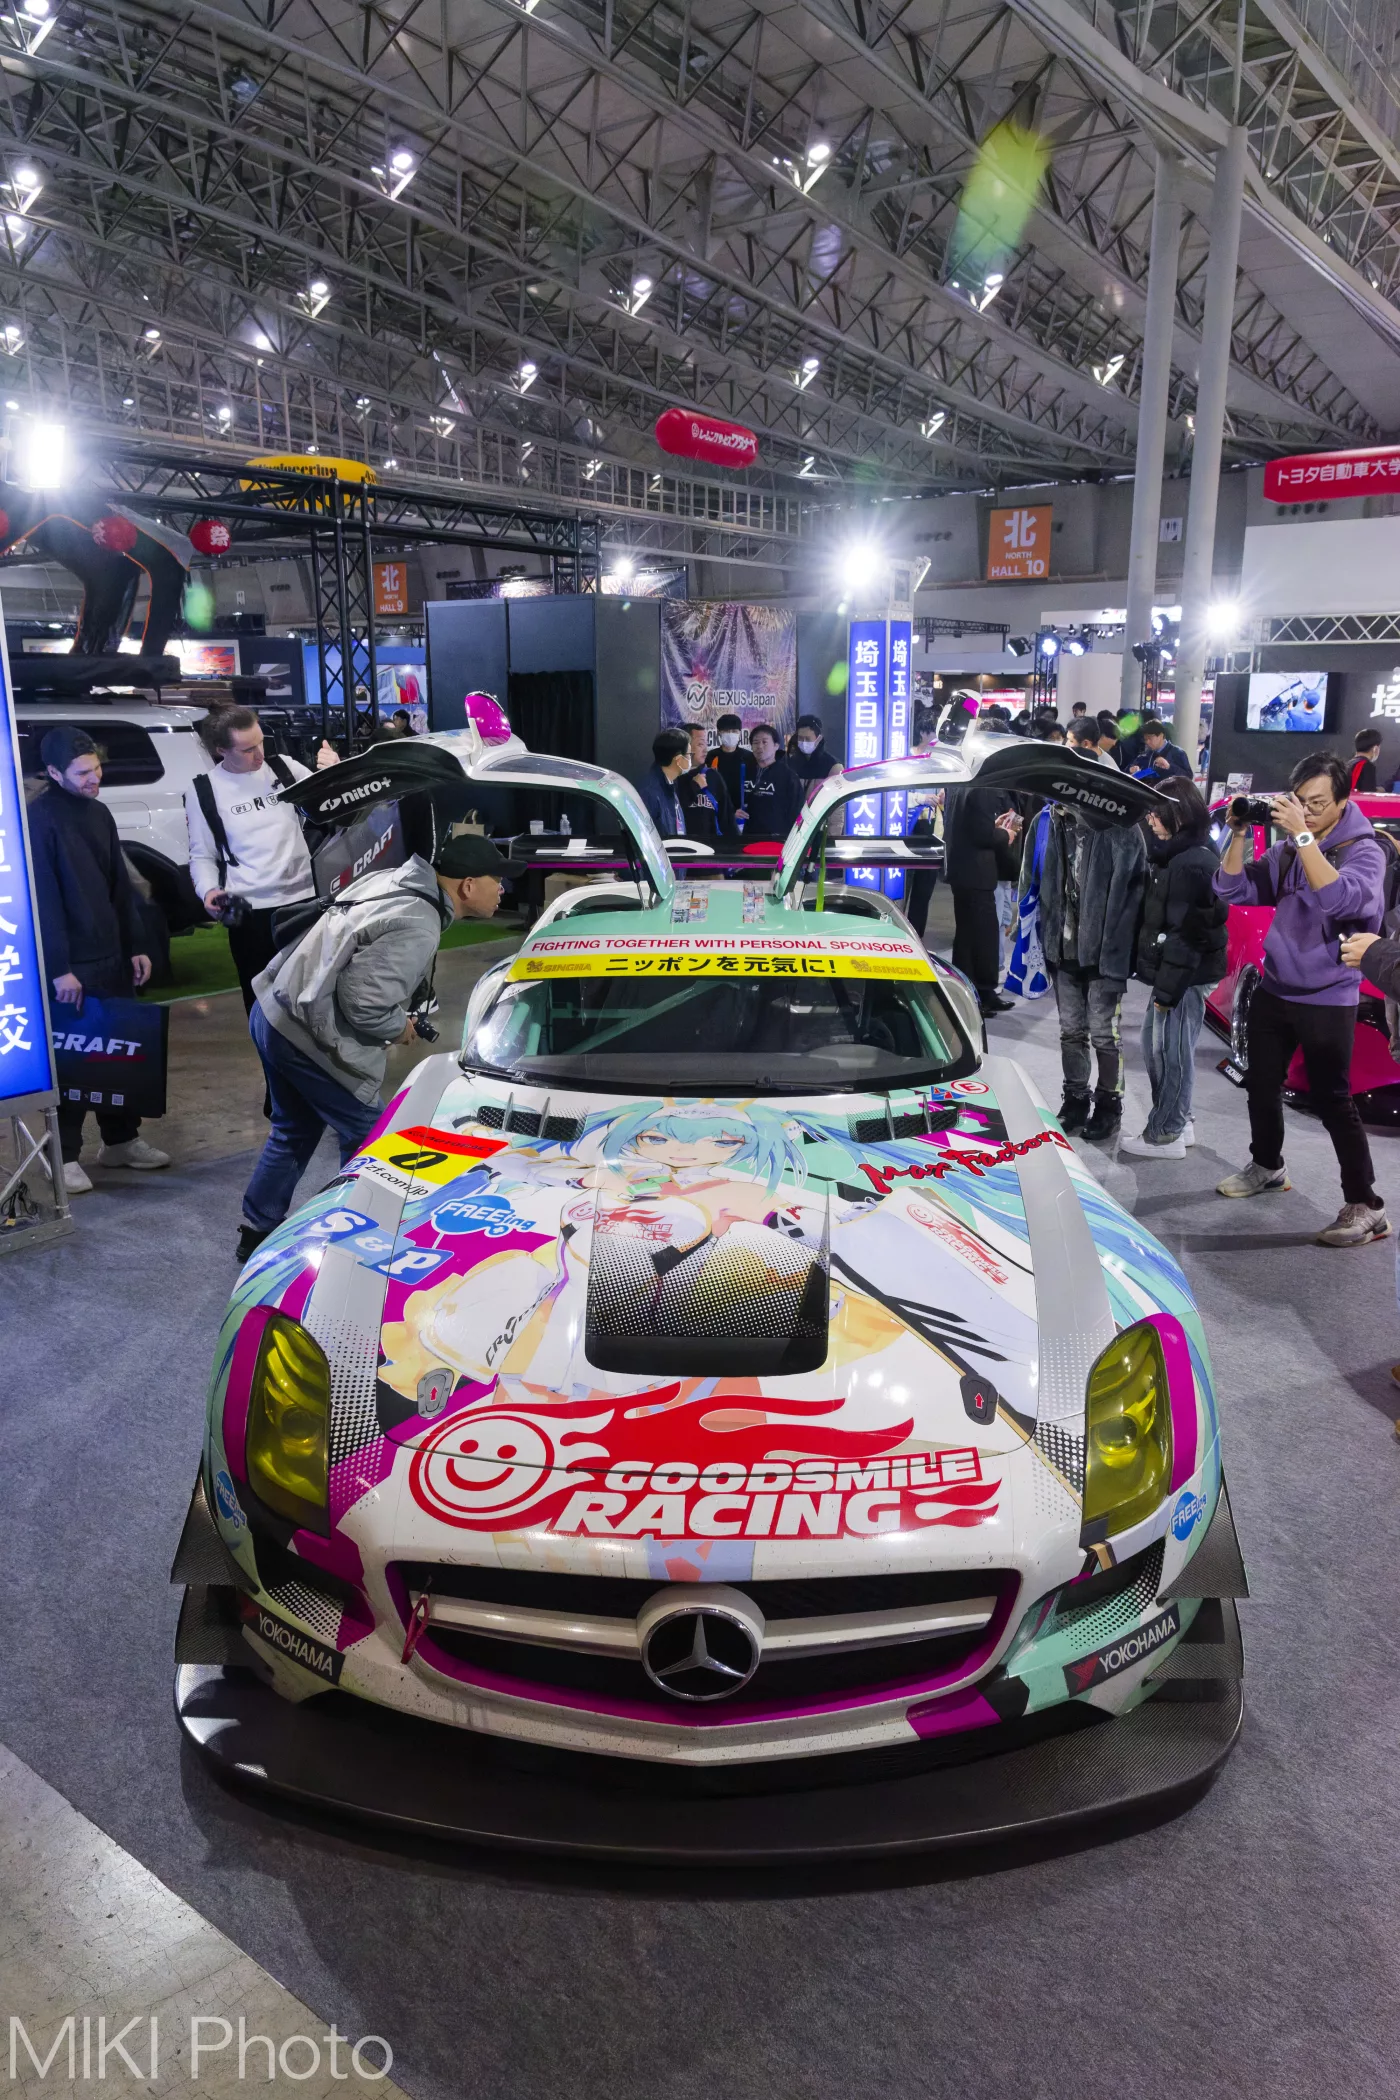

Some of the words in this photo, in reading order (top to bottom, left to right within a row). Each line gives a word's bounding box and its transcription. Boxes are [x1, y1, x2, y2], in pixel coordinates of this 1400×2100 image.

[1003, 510, 1037, 549] 北
[991, 565, 1021, 577] HALL
[1026, 559, 1045, 576] 10
[1005, 551, 1032, 559] NORTH
[381, 564, 399, 592] 北
[380, 603, 396, 612] HALL
[397, 600, 404, 611] 9
[713, 691, 747, 706] NEXUS
[748, 691, 776, 709] Japan
[341, 777, 392, 805] nitro+
[1076, 789, 1128, 816] nitro+
[353, 824, 394, 878] CRAFT
[532, 940, 601, 952] FIGHTING
[605, 939, 690, 949] TOGETHER
[694, 939, 735, 949] WITH
[740, 939, 827, 950] PERSONAL
[829, 940, 915, 955] SPONSORS
[605, 956, 837, 974] ニッポンを元気に!
[388, 1151, 449, 1171] 0
[364, 1164, 429, 1197] zf.com/jp
[604, 1449, 978, 1492] GOODSMILE
[553, 1490, 901, 1537] RACING
[259, 1612, 333, 1676] YOKOHAMA
[1099, 1615, 1176, 1673] YOKOHAMA
